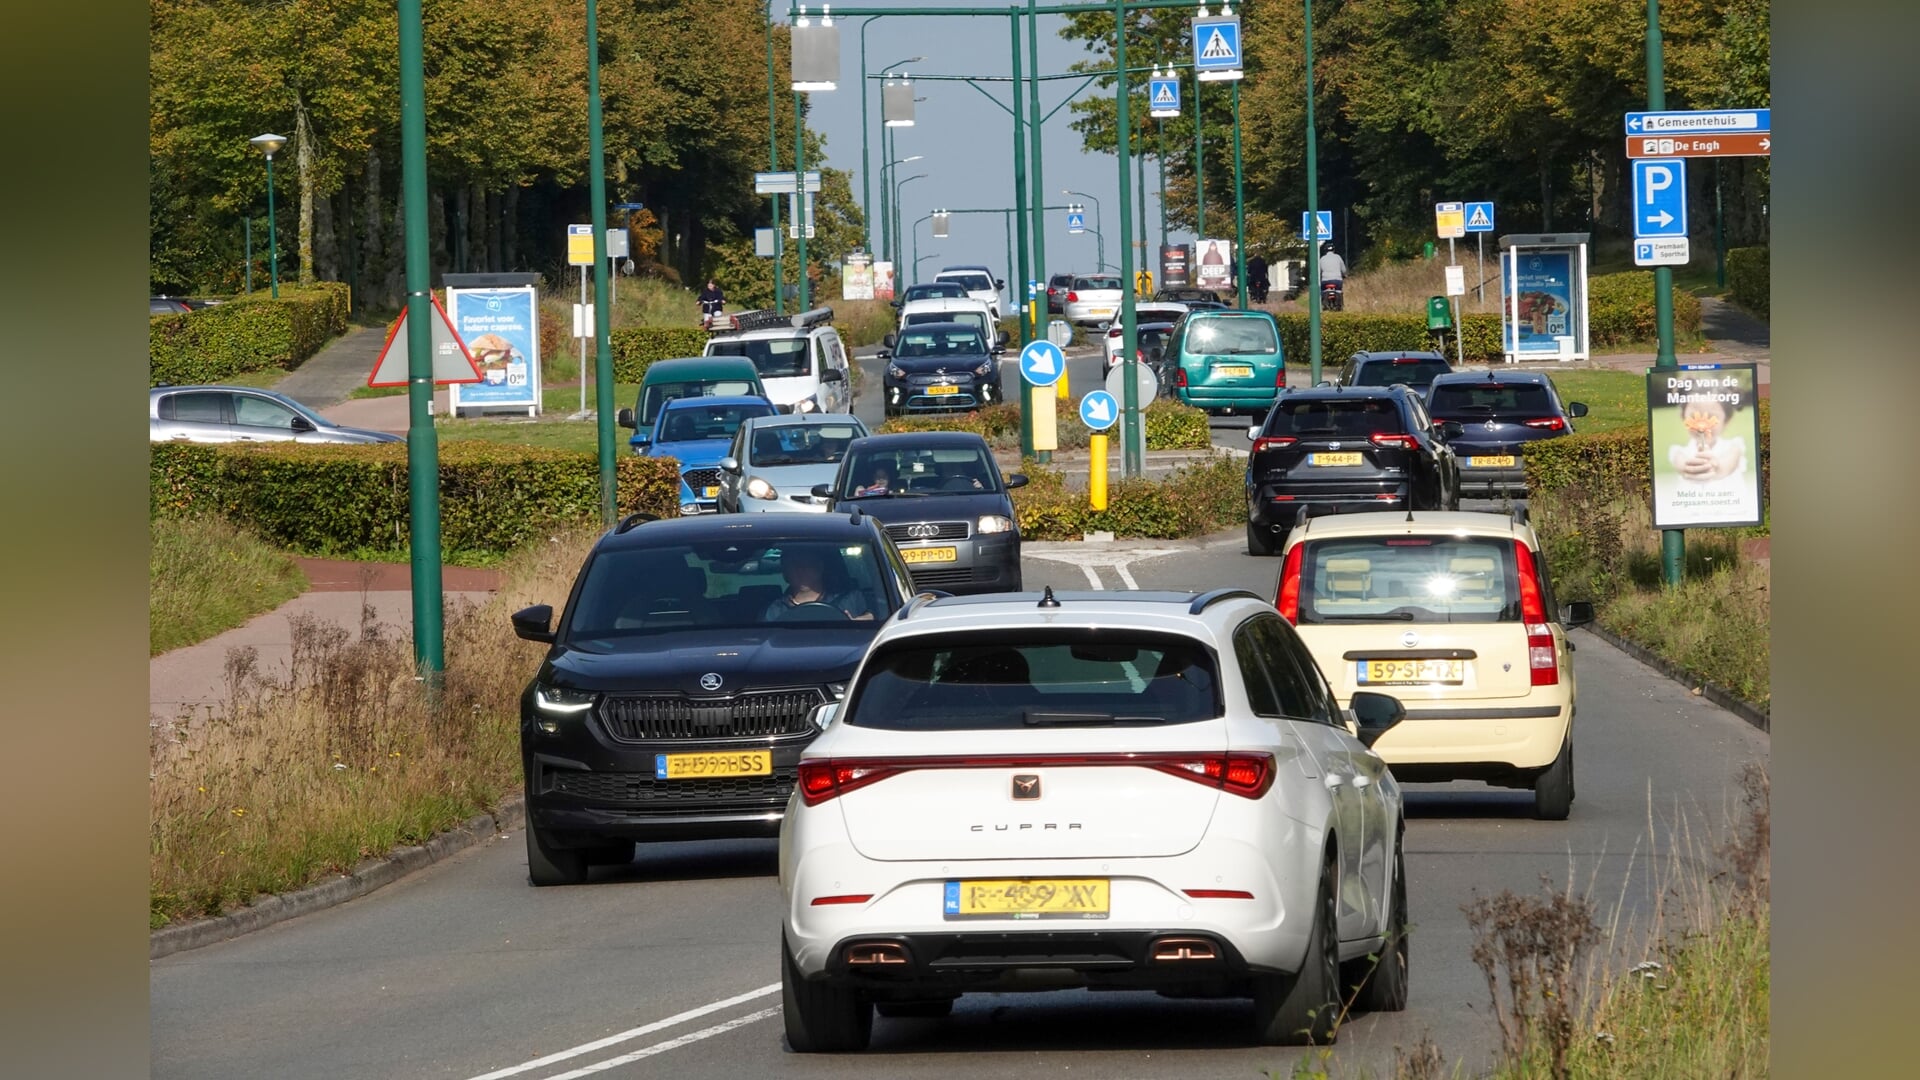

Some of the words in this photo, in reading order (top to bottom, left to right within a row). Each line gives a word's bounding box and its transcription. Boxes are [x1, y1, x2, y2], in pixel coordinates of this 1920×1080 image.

[1657, 116, 1737, 127] Gemeentehuis
[1675, 141, 1689, 151] De
[1692, 141, 1720, 152] Engh
[1645, 166, 1673, 205] P
[1667, 377, 1692, 391] Dag
[1696, 379, 1719, 387] van
[1722, 375, 1738, 387] de
[1667, 391, 1740, 404] Mantelzorg
[1677, 490, 1696, 498] Meld
[970, 823, 1082, 832] CUPRA
[946, 901, 958, 909] NL
